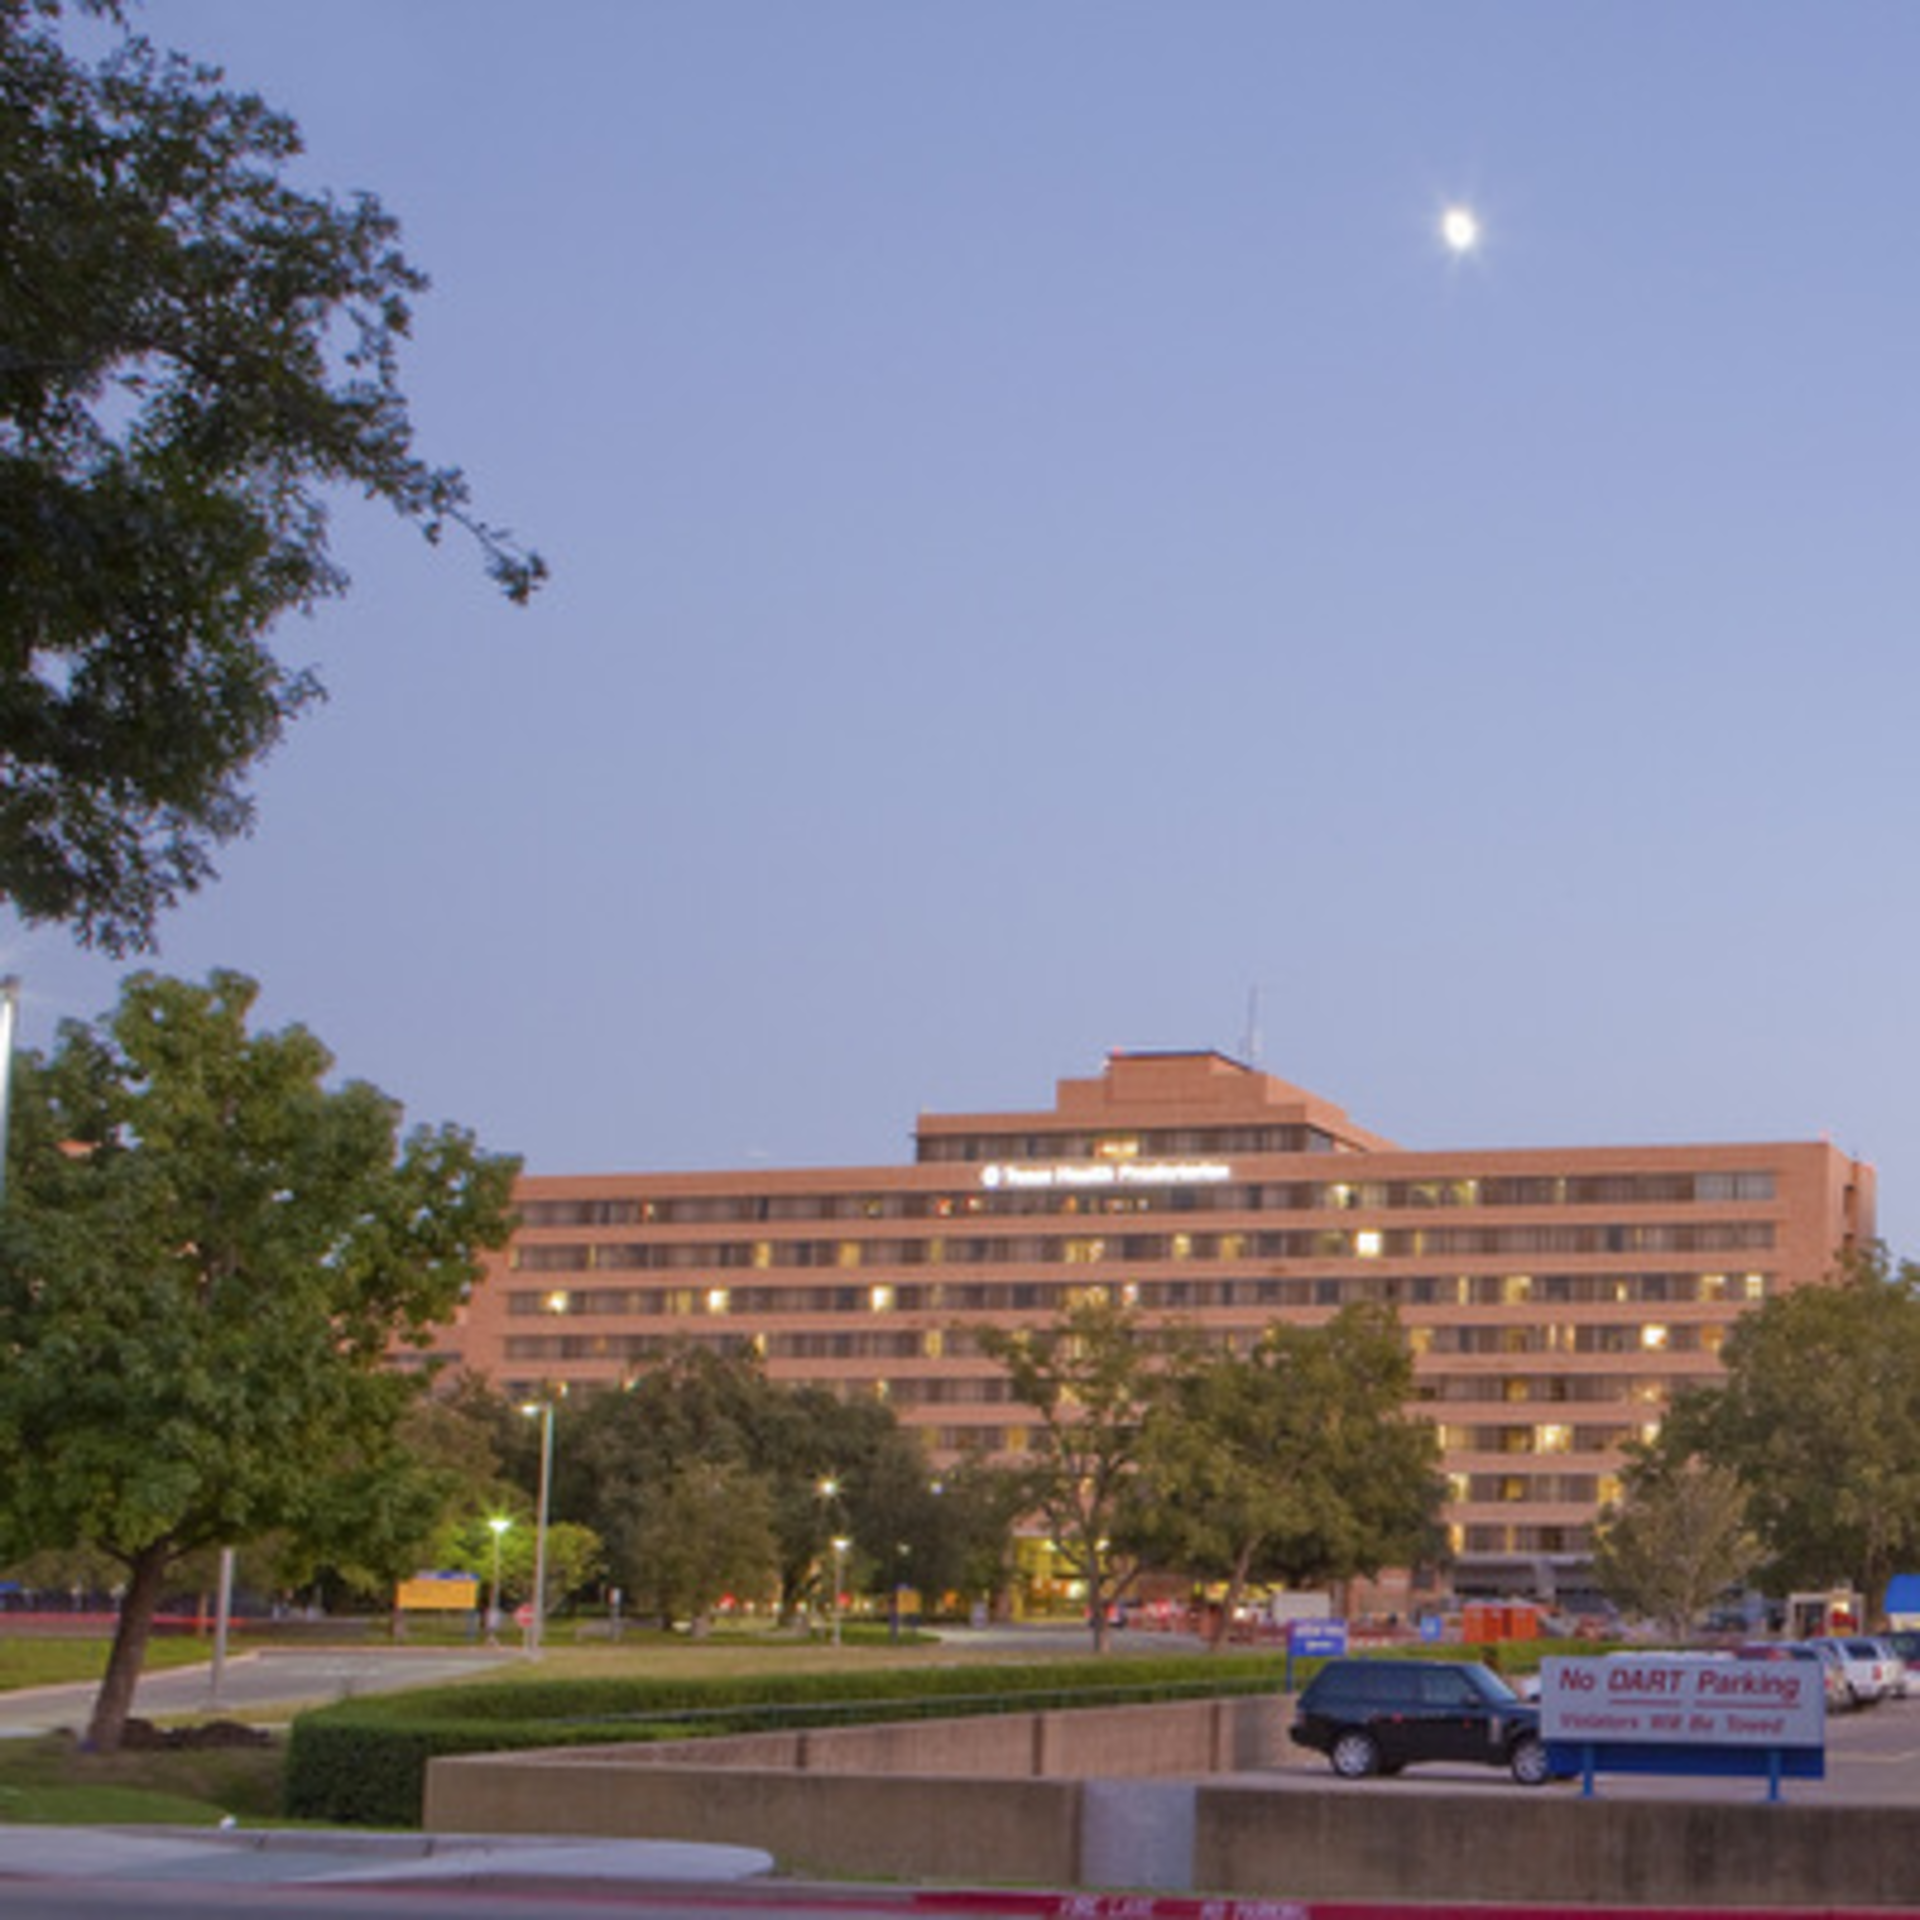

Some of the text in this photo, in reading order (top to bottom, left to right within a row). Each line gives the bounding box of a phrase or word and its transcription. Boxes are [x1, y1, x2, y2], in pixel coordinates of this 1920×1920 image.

[1559, 1668, 1800, 1701] No DART Parking
